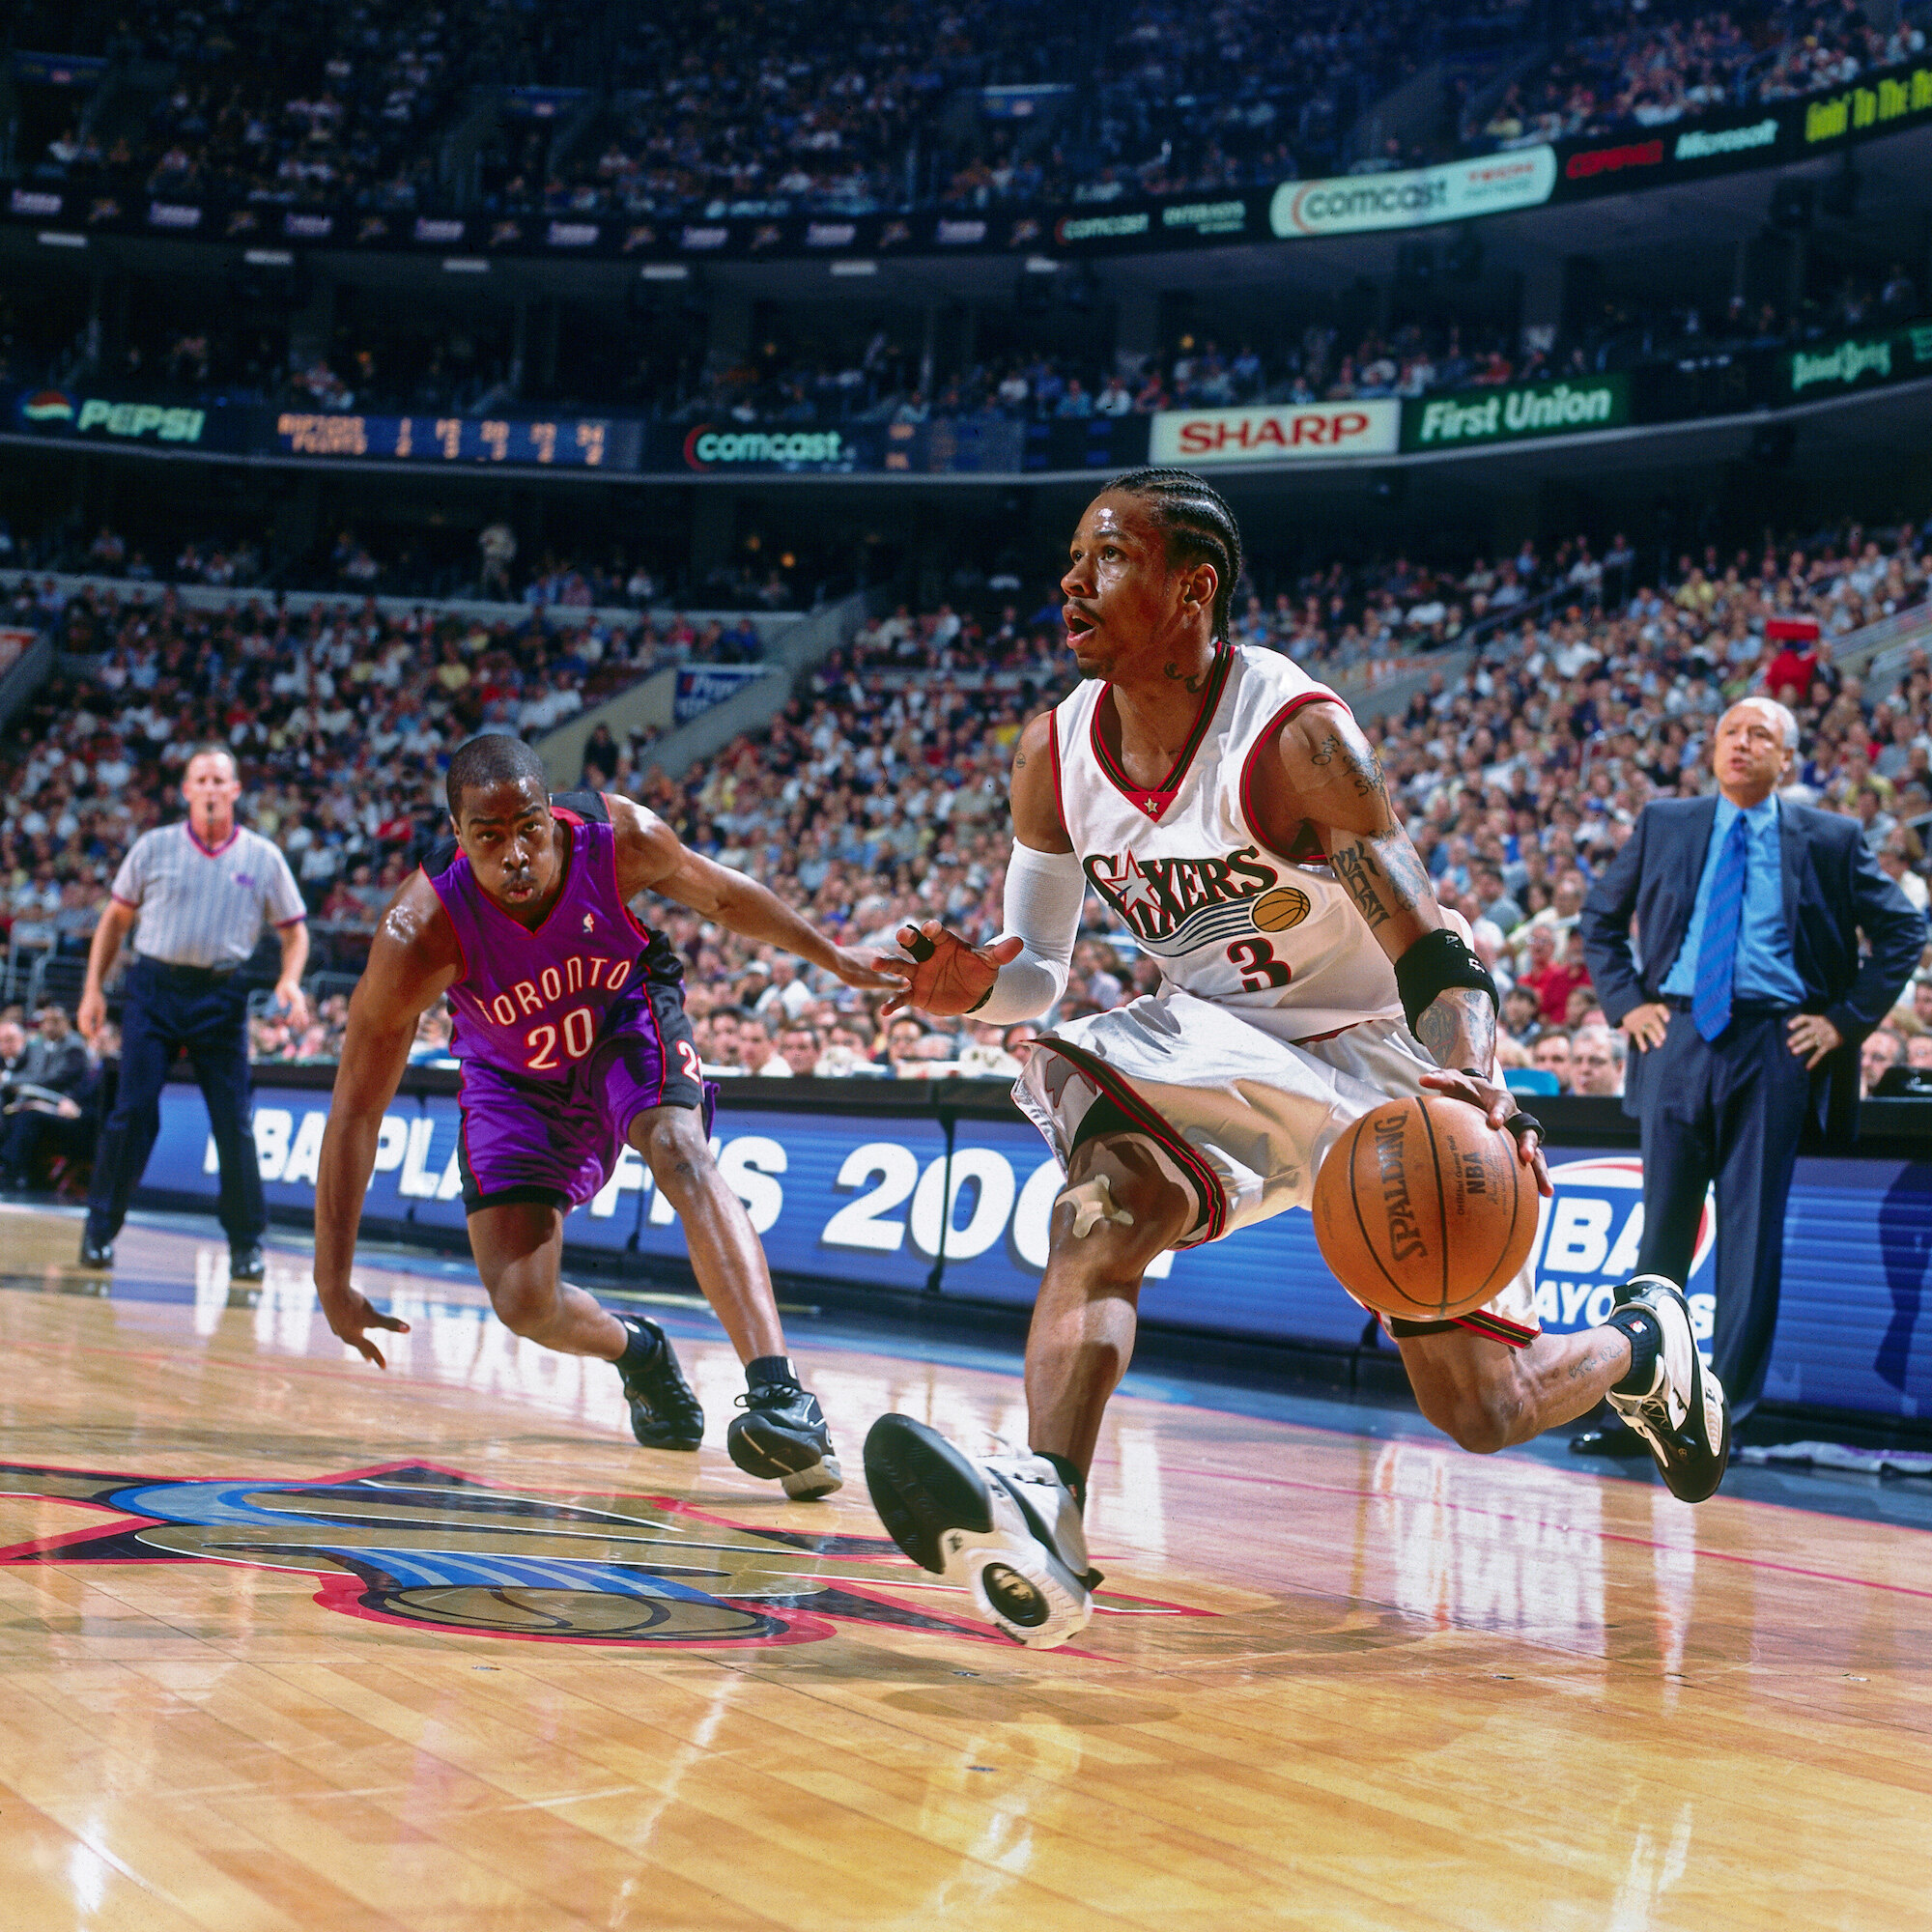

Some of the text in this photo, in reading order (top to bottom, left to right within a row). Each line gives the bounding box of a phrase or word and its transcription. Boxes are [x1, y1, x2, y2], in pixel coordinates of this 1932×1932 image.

[1675, 118, 1778, 160] Microsoft
[1305, 181, 1447, 220] comcast
[1063, 213, 1150, 241] comcast
[77, 399, 206, 442] PEPSI
[1179, 412, 1370, 455] SHARP
[1420, 385, 1611, 442] First Union
[696, 430, 841, 462] comcast
[1227, 937, 1292, 993] 3
[472, 956, 632, 1027] TORONTO
[524, 1007, 596, 1070] 20
[676, 1040, 704, 1086] 2
[203, 1108, 329, 1182] BA
[1374, 1109, 1429, 1263] SPALDING
[1463, 1151, 1487, 1195] NBA
[1535, 1196, 1645, 1277] BA
